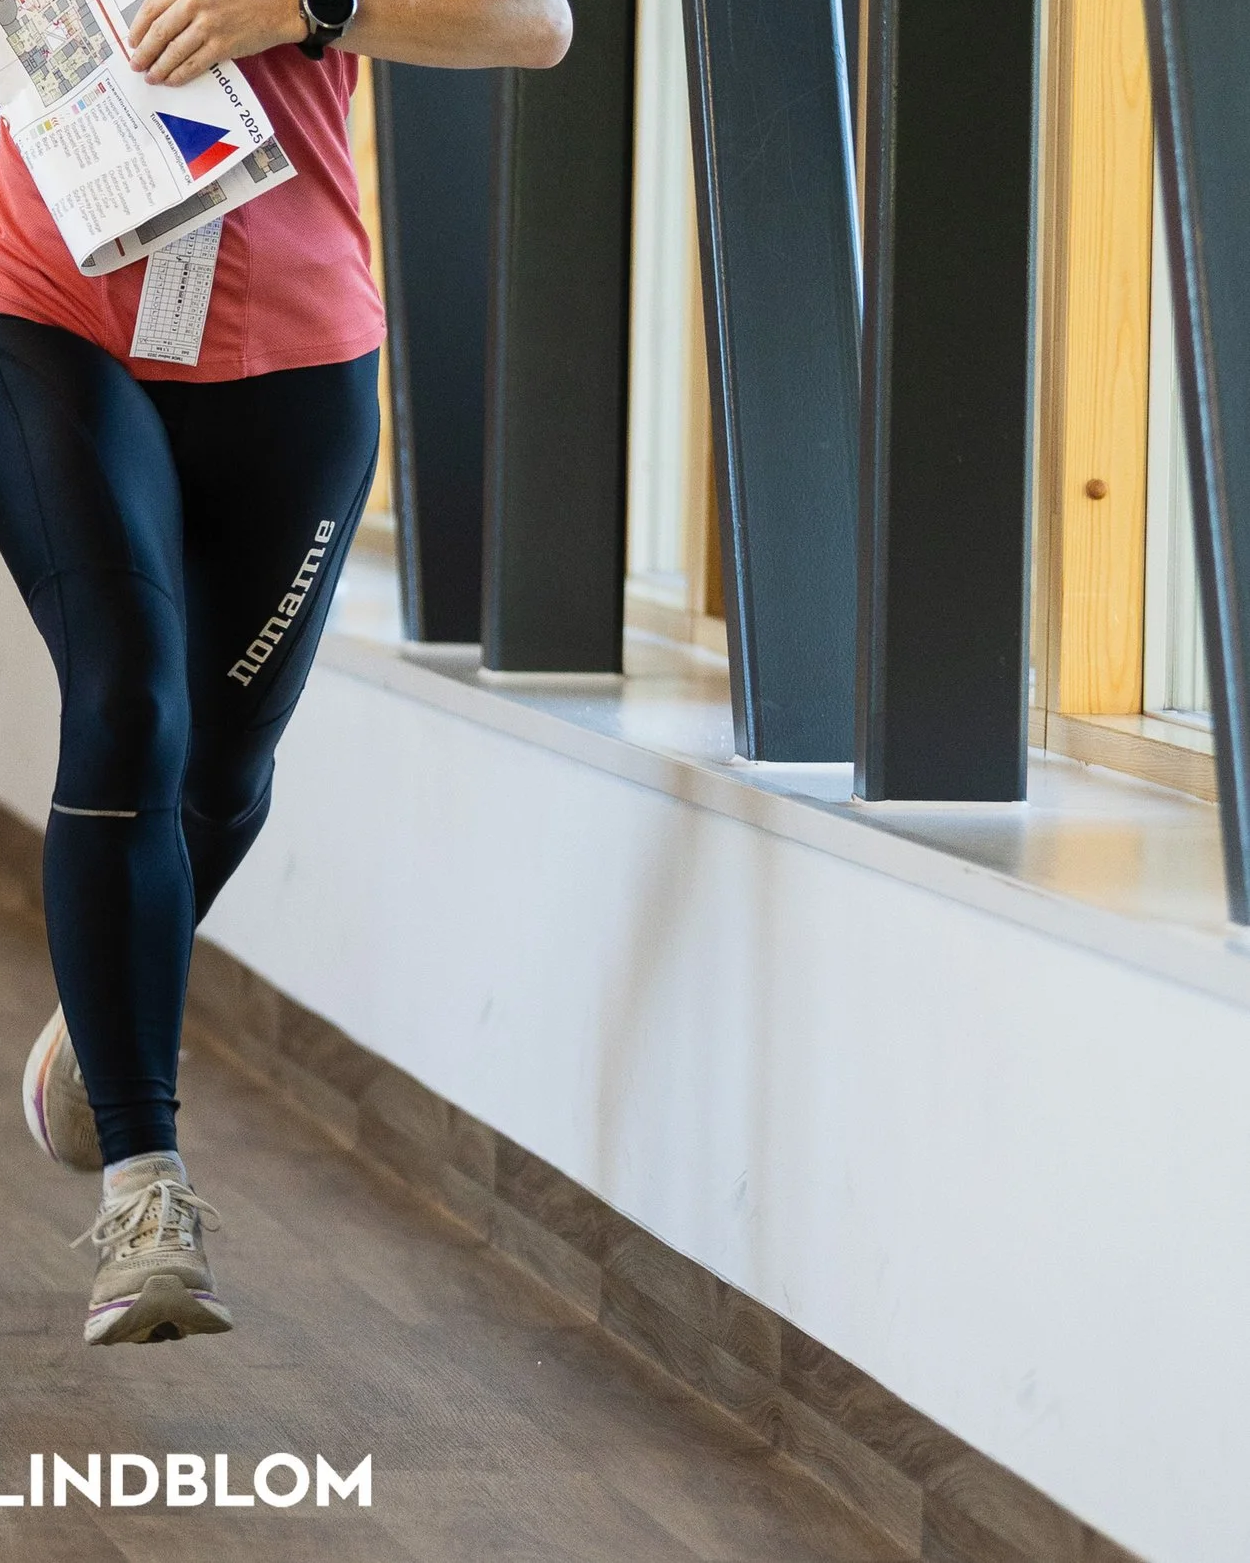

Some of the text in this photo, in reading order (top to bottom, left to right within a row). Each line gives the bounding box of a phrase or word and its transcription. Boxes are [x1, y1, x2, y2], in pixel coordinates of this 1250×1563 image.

[207, 61, 264, 145] Indoor 2025
[183, 173, 193, 186] OK
[227, 520, 336, 687] noname
